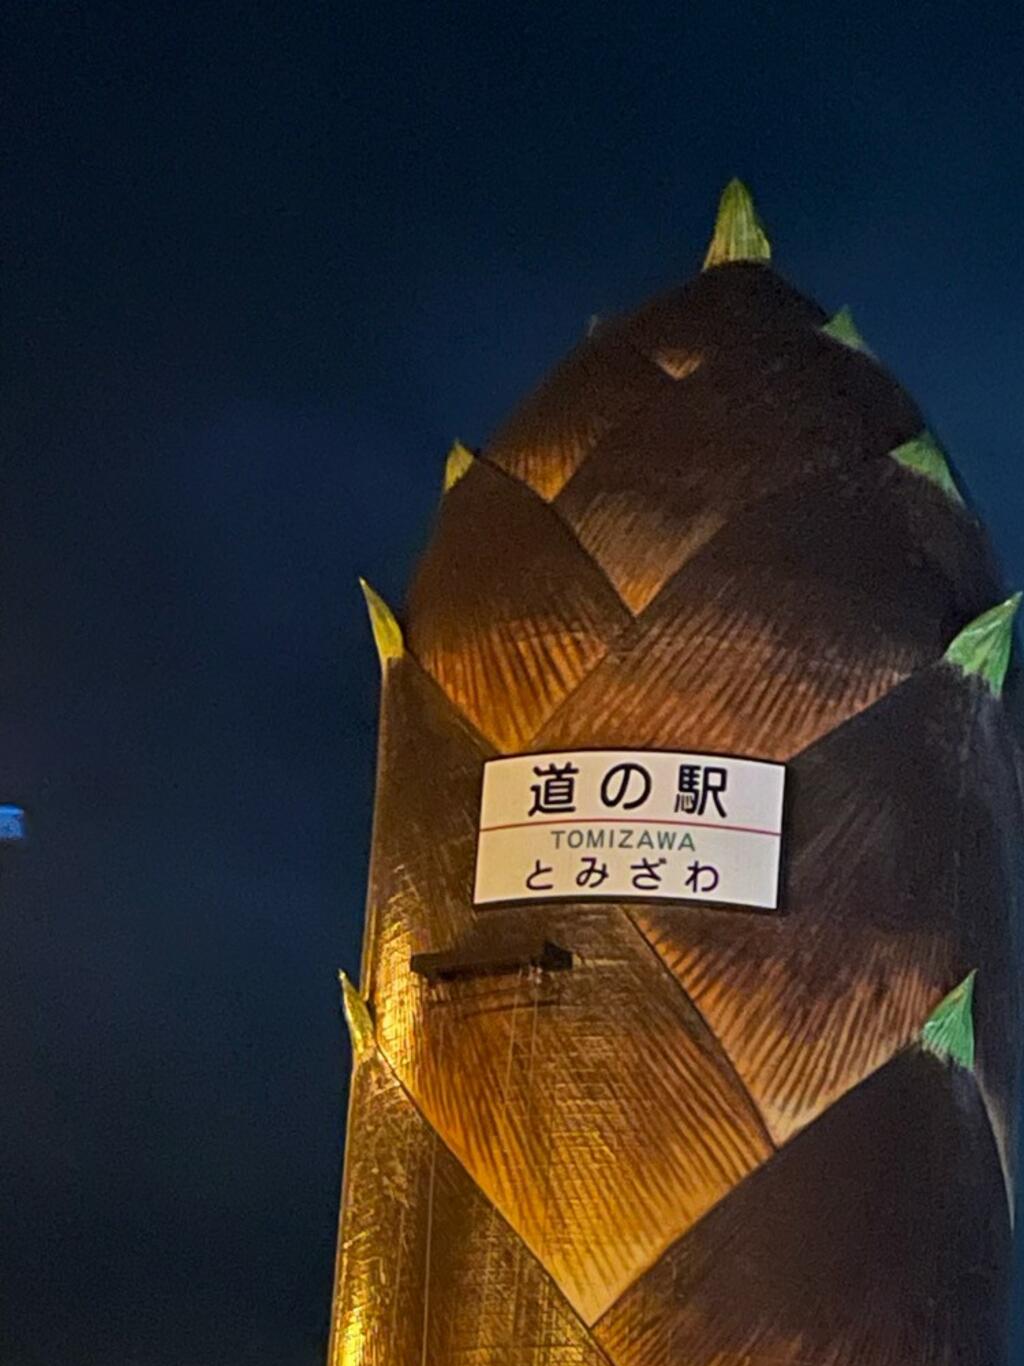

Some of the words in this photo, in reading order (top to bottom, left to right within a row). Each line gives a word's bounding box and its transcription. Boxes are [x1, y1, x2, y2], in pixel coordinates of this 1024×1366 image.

[528, 761, 728, 818] 道の駅
[550, 829, 696, 851] TOMIZAWA
[526, 857, 720, 893] とみざわ
